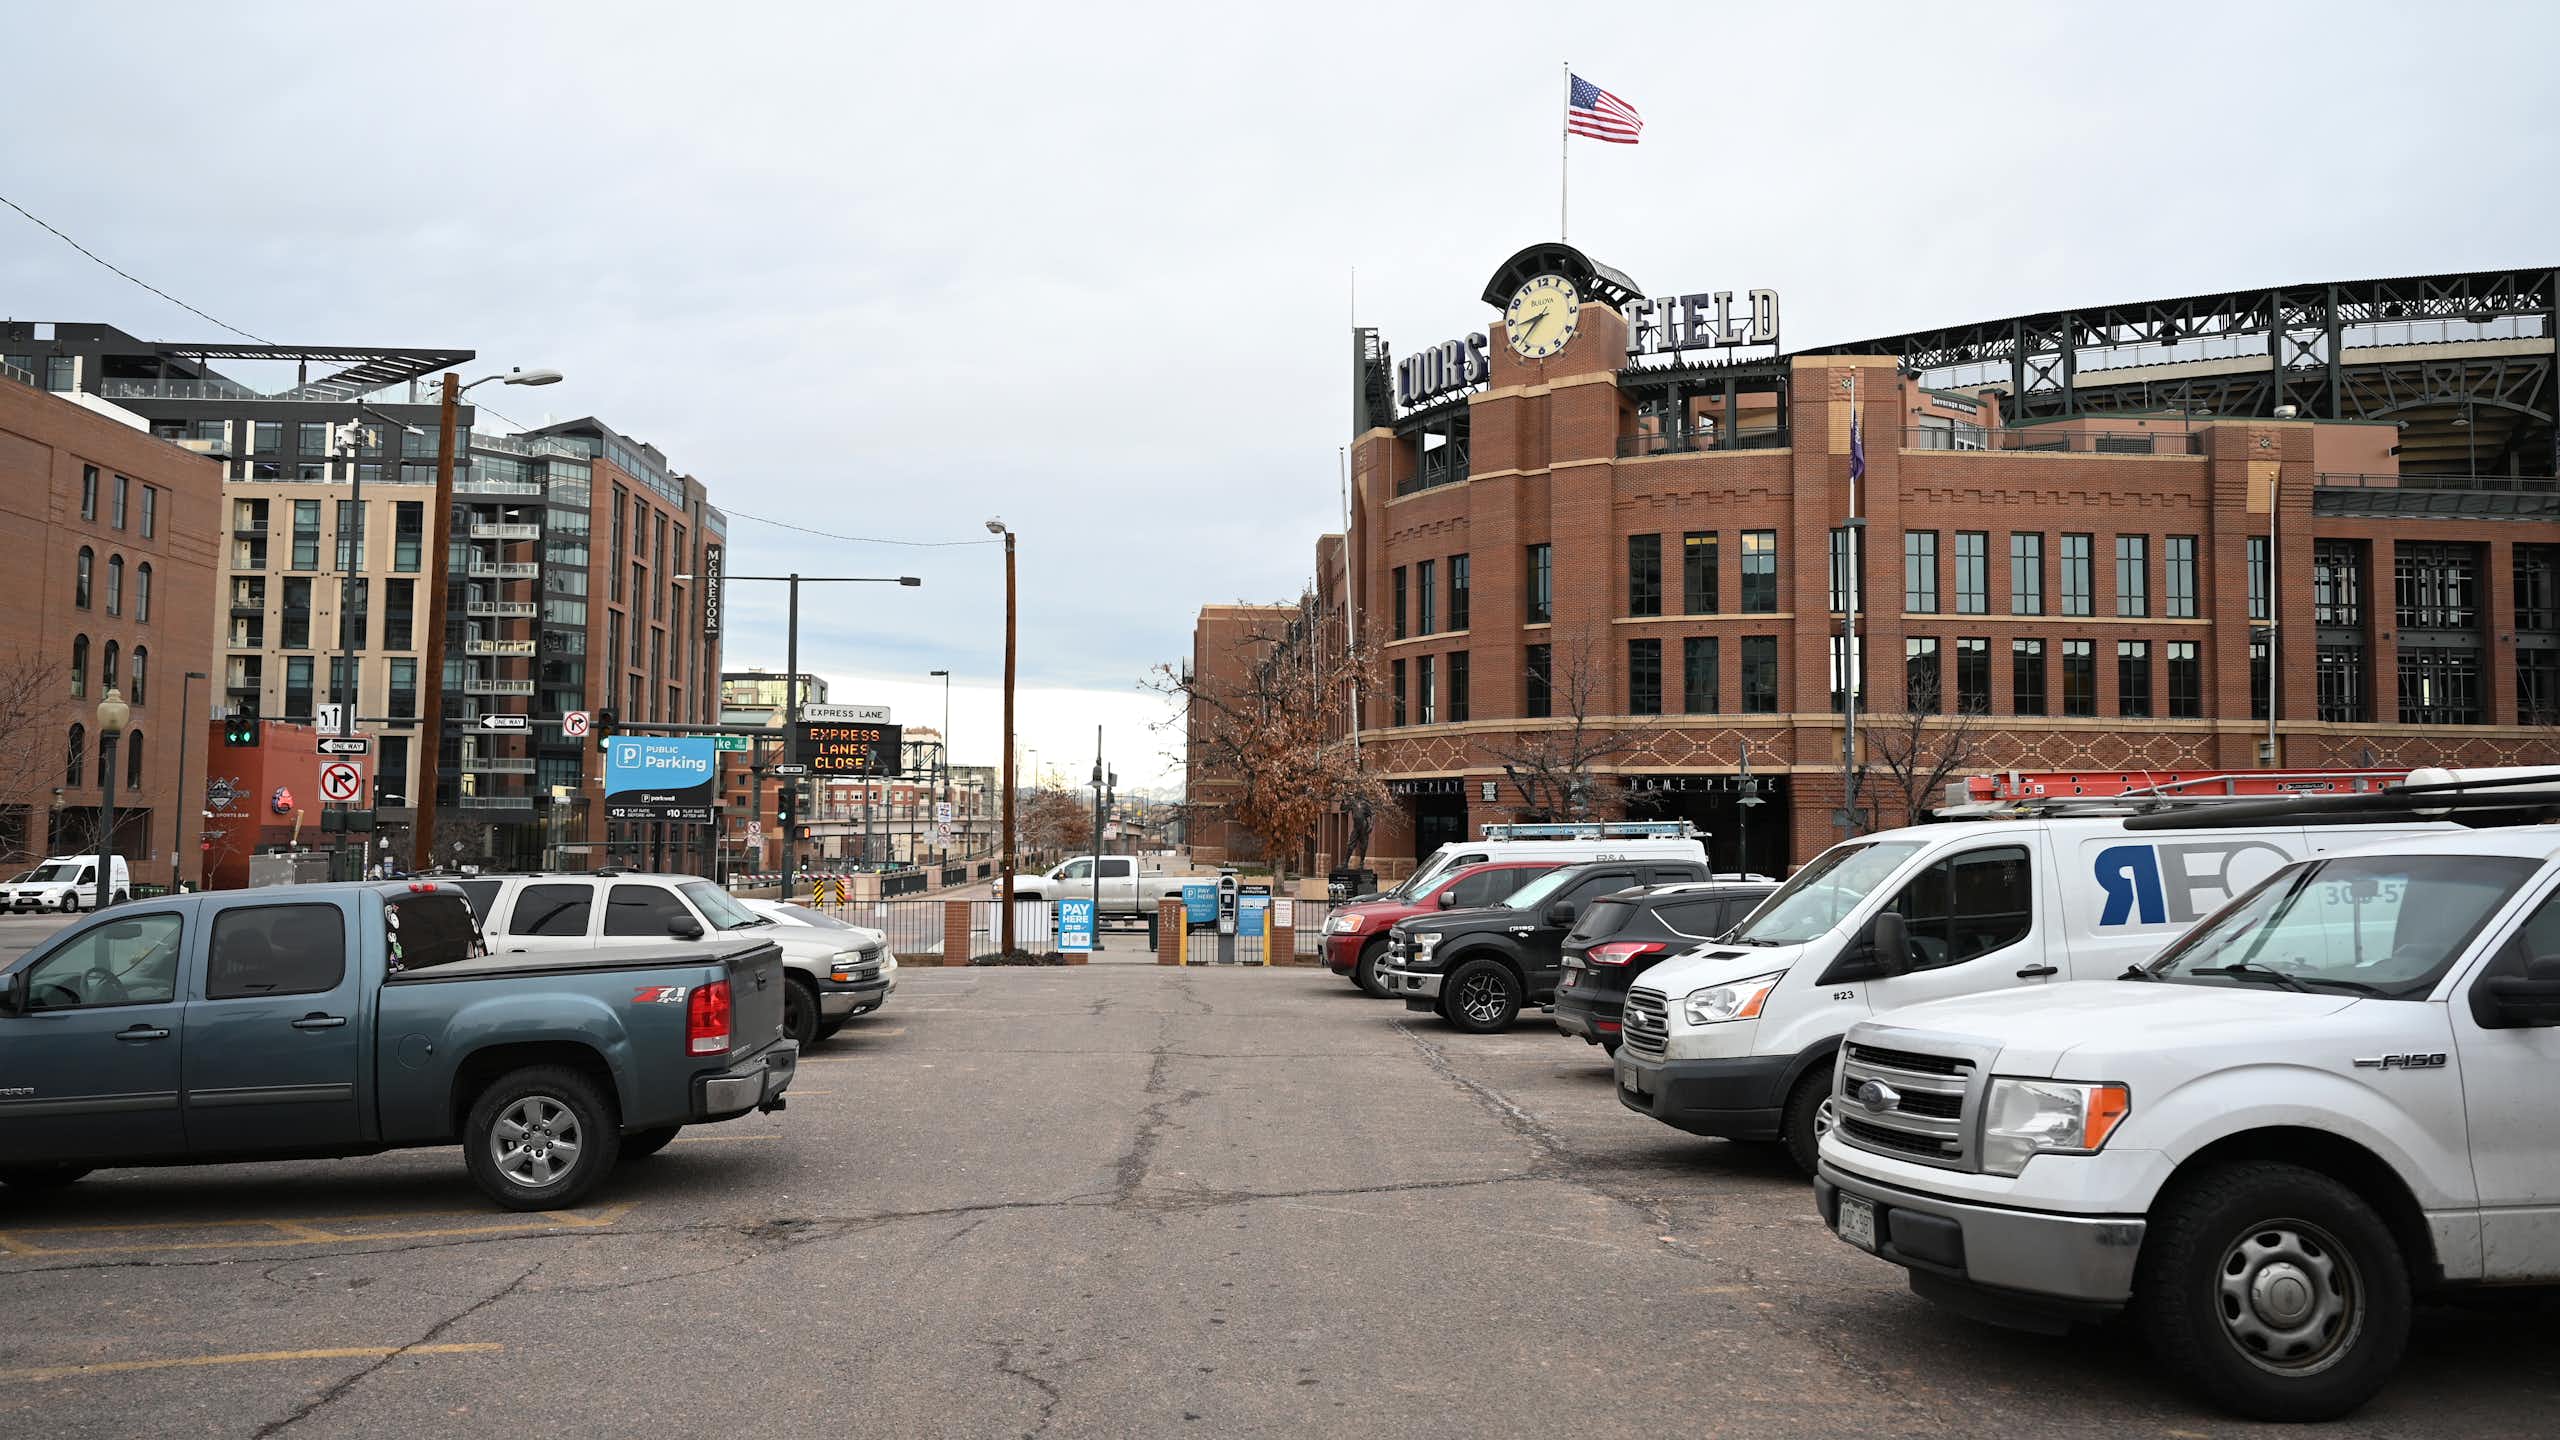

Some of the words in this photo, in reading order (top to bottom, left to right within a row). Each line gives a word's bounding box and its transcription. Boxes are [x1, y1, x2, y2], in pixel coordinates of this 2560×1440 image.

[1537, 278, 1549, 288] 12
[1522, 284, 1532, 295] 11
[1564, 289, 1574, 298] 2
[1510, 298, 1521, 310] 10
[1530, 298, 1554, 308] BULOVA
[1508, 319, 1516, 327] 9
[1625, 289, 1778, 354] FIELD
[1564, 325, 1572, 334] 4
[1512, 334, 1520, 344] 8
[1554, 339, 1561, 348] 5
[1523, 344, 1530, 352] 7
[1538, 346, 1546, 355] 6
[1397, 332, 1488, 406] COORS
[810, 708, 854, 718] EXPRESS
[810, 728, 880, 742] EXPRESS
[332, 742, 345, 750] ONE
[646, 746, 678, 754] PUBLIC
[820, 744, 869, 756] LANES
[646, 756, 706, 772] Parking
[815, 757, 875, 770] CLOSE
[1632, 779, 1686, 790] HOME
[612, 808, 625, 817] $12
[666, 809, 680, 818] $10
[1062, 904, 1090, 914] PAY
[631, 985, 686, 1002] Z71
[1834, 990, 1854, 1000] #23
